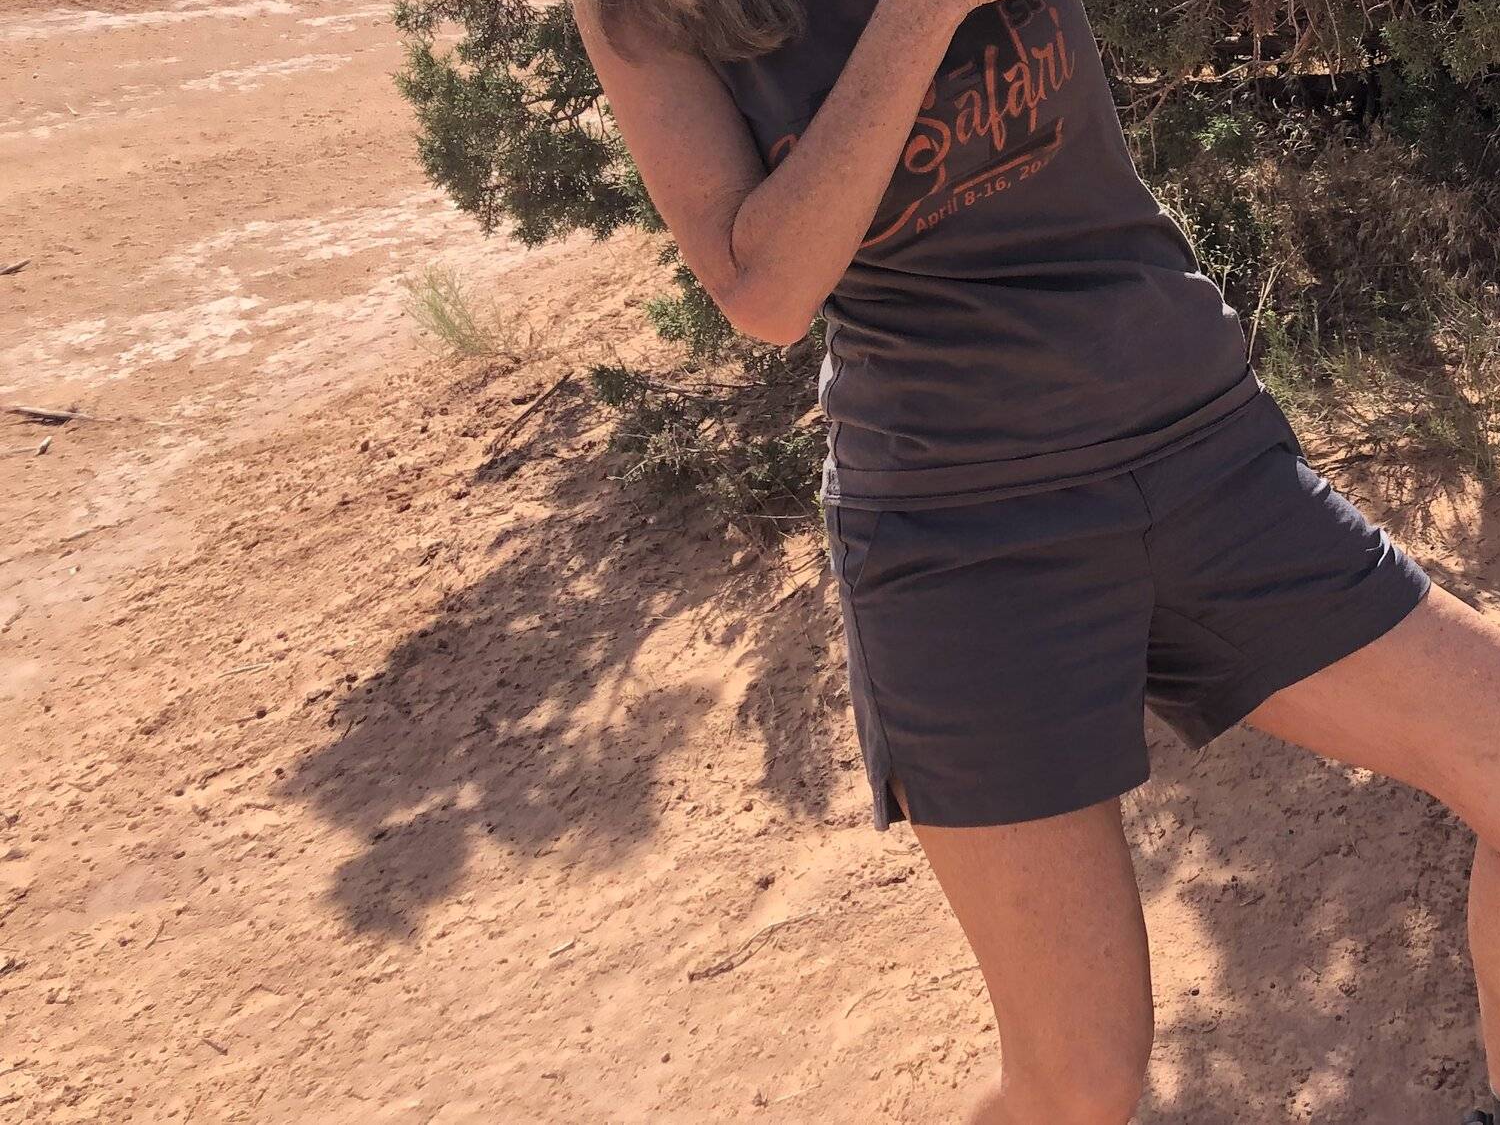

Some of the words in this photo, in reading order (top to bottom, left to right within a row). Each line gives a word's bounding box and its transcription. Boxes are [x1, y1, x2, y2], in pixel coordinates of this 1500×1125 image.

[904, 7, 1075, 193] Safari
[915, 196, 959, 234] April
[964, 176, 1012, 206] 8-16,
